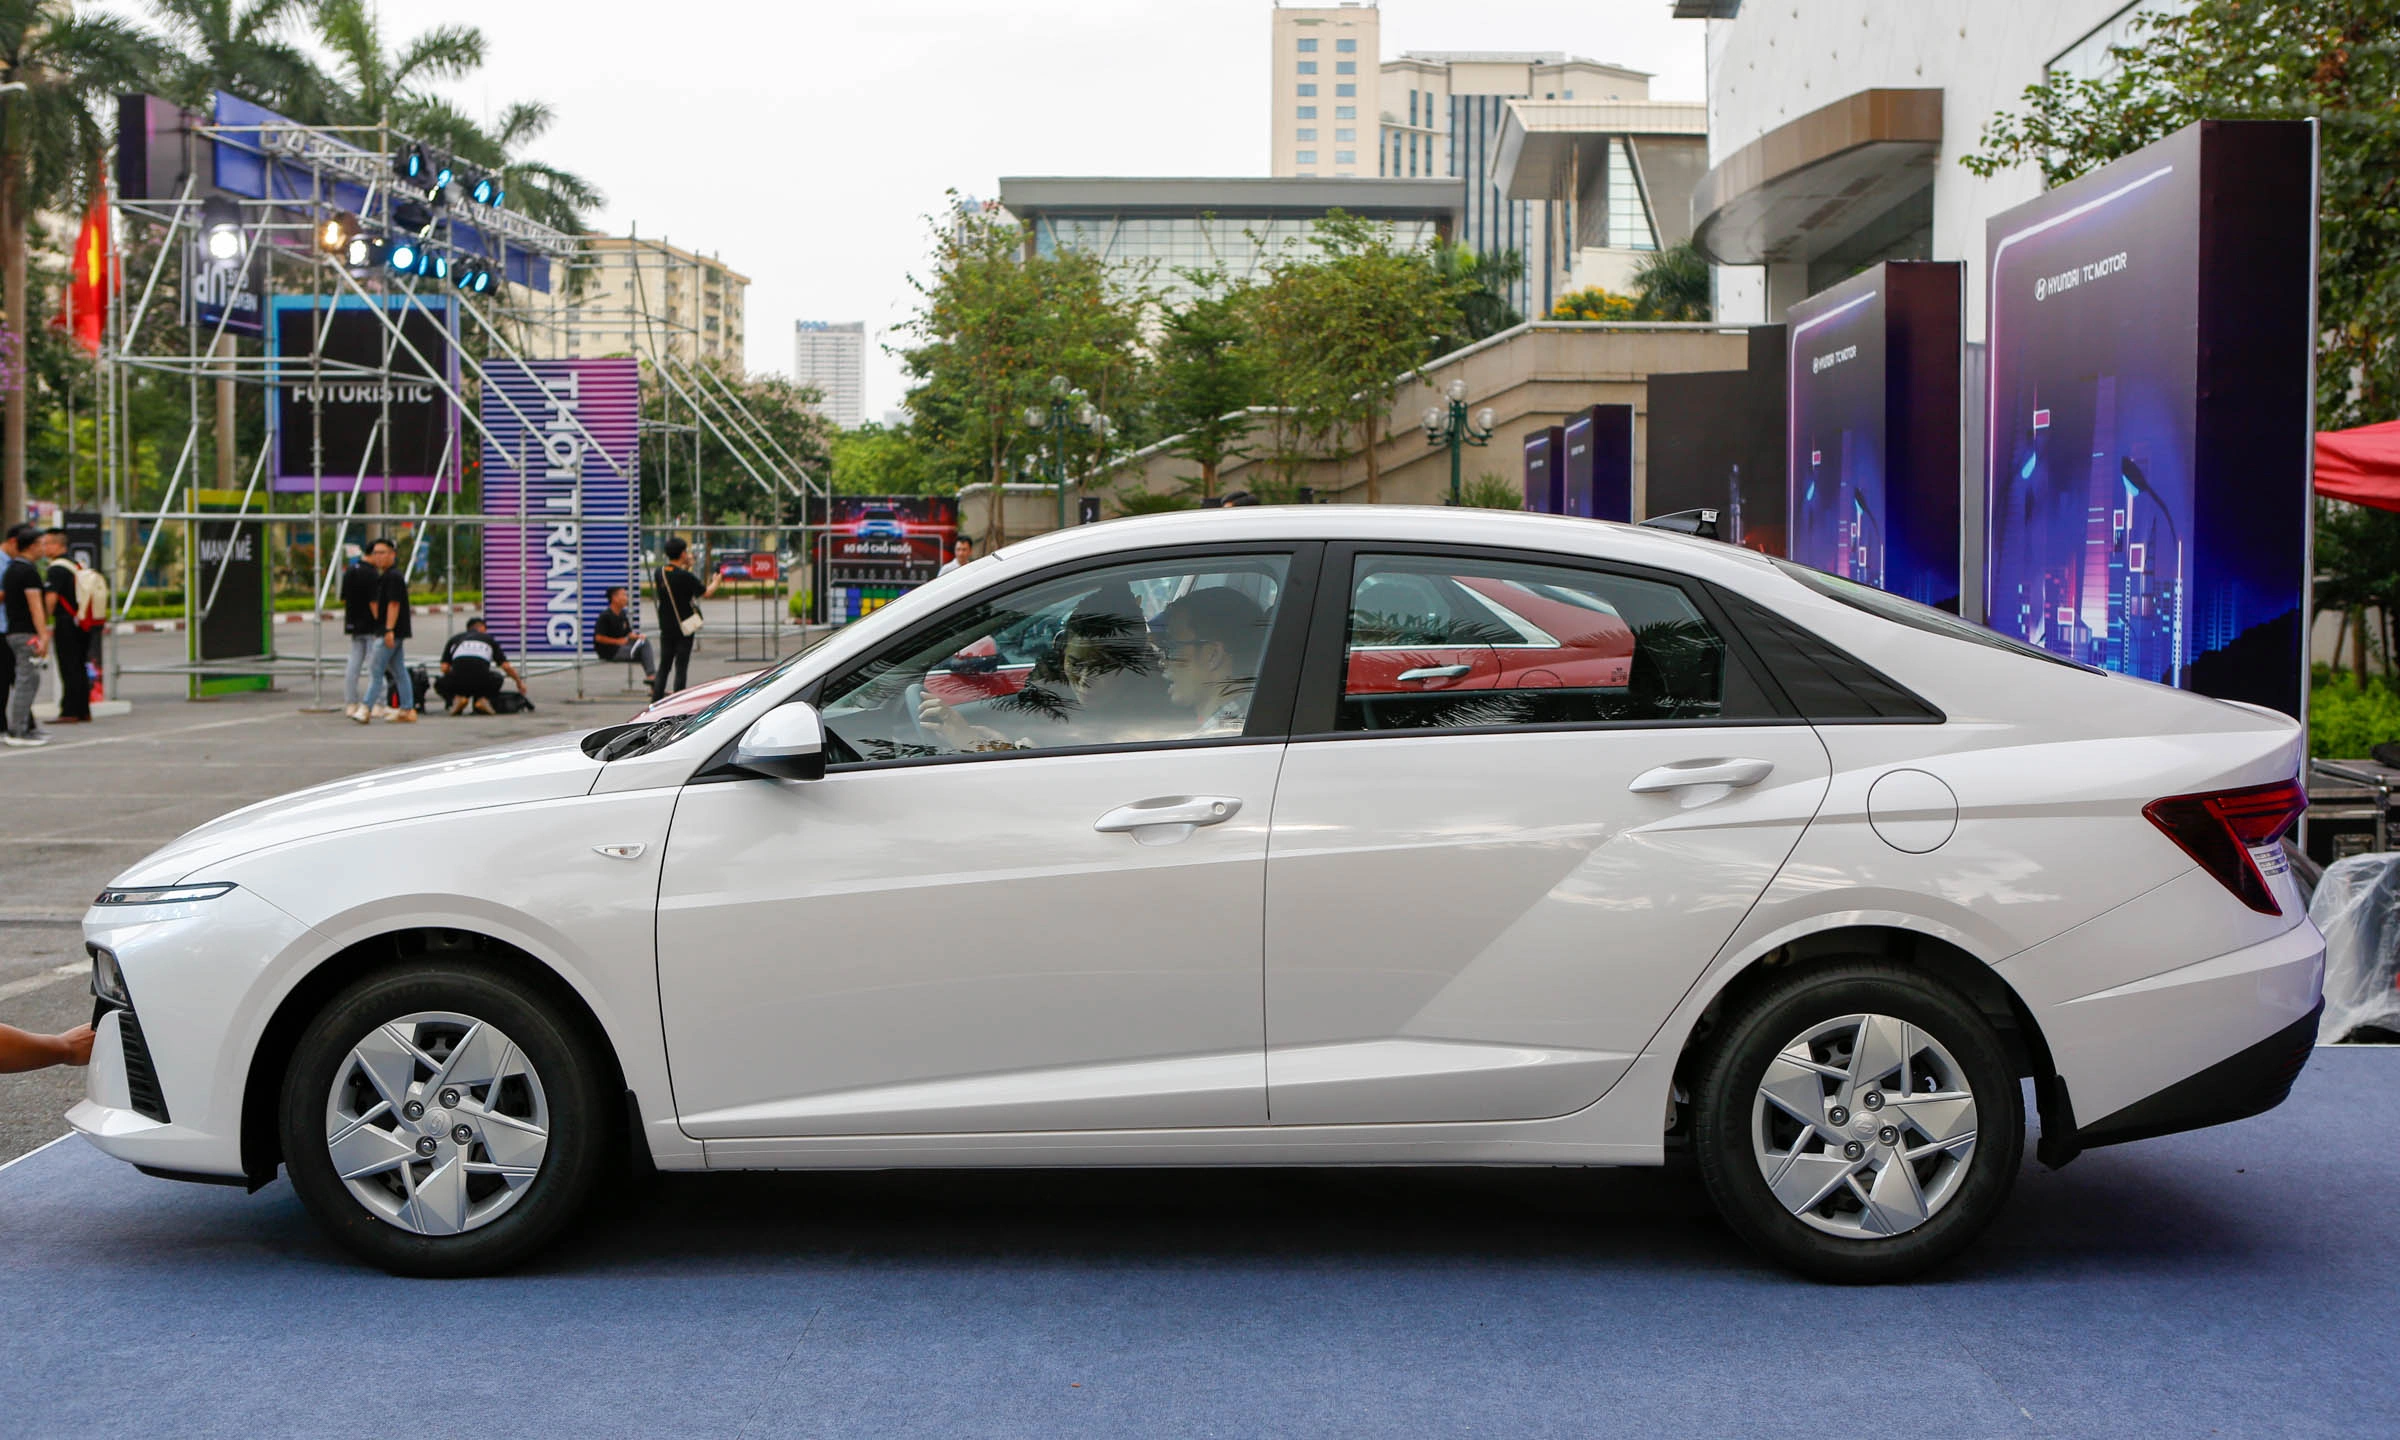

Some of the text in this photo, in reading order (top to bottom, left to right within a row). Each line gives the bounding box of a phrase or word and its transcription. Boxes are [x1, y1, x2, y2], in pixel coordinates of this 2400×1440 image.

[195, 262, 226, 307] UP
[2047, 267, 2080, 295] HYUNDAI
[292, 385, 433, 403] FUTURISTIC
[546, 488, 579, 648] TRANG
